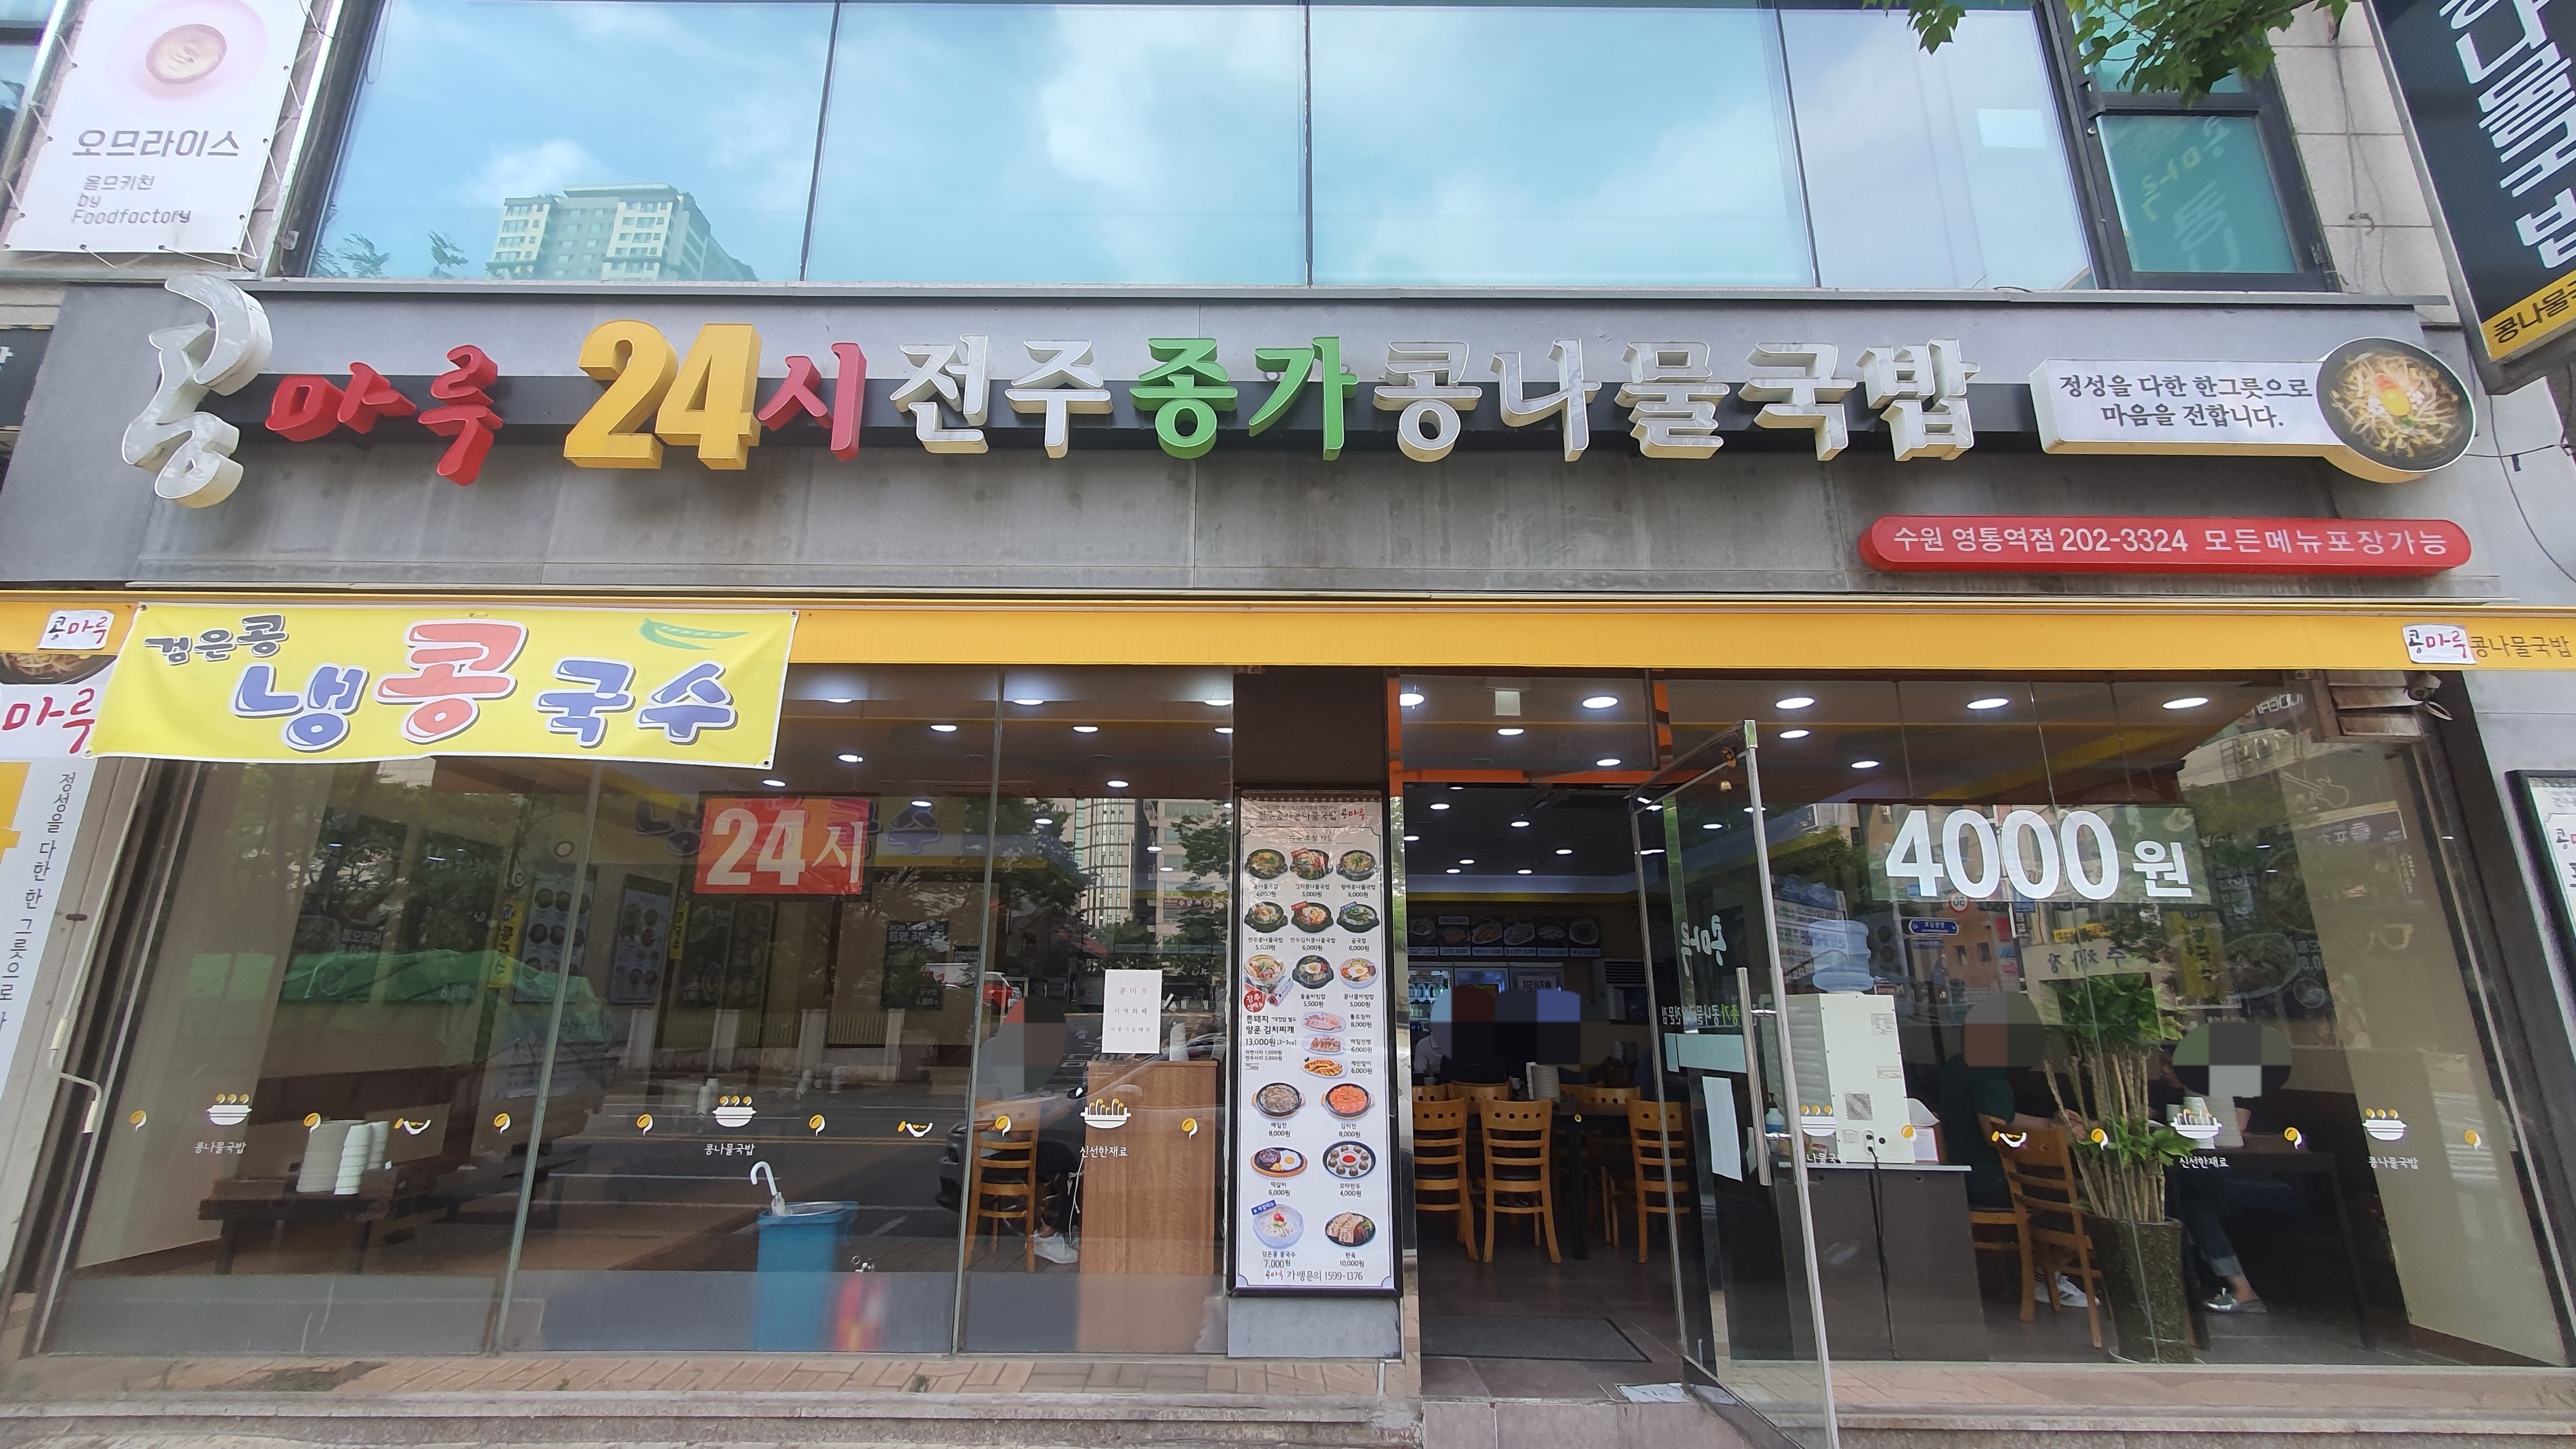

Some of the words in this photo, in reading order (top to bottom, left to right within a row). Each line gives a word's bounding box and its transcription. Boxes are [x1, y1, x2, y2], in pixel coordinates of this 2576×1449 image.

[72, 129, 239, 158] 오므라이스
[83, 174, 155, 191] 옴므키친
[77, 193, 102, 209] by
[70, 208, 192, 224] Foodfactory
[563, 319, 867, 471] 24시
[2059, 374, 2133, 399] 정성을
[2140, 375, 2187, 397] 다한
[2193, 376, 2314, 400] 한그릇으로
[2101, 402, 2176, 427] 마음을
[2182, 403, 2285, 429] 전합니다.
[1893, 527, 1943, 552] 수원
[1951, 527, 2055, 553] 영통역점
[2059, 527, 2188, 554] 202-3324
[2204, 528, 2447, 556] 모든메뉴포장가능
[48, 616, 107, 645] 콩마루
[144, 614, 289, 666] 검은콩
[2408, 629, 2467, 659] 콩마루
[2470, 634, 2572, 658] 콩나물국밥
[230, 618, 738, 753] 냉콩국수
[46, 771, 77, 834] 정성을
[1341, 808, 1365, 821] 콩마루
[705, 807, 868, 886] 24시
[32, 839, 58, 882] 다한
[1246, 993, 1262, 1003] 강추
[1246, 1015, 1269, 1024] 통돼지
[1246, 1025, 1261, 1035] 양푼
[1263, 1025, 1294, 1035] 김치찌개
[1246, 1038, 1276, 1047] 13,000원
[194, 1141, 247, 1156] 콩나물국밥
[704, 1143, 756, 1157] 콩나물국밥
[1079, 1145, 1129, 1158] 신선한재료
[1806, 1152, 1847, 1166] 나물국
[2177, 1154, 2230, 1169] 신선한재료
[2367, 1155, 2419, 1170] 콩나물국밥
[1264, 1259, 1291, 1268] 7,000원
[1339, 1259, 1365, 1268] 10,000원
[1287, 1270, 1322, 1282] 가맹문의
[1324, 1271, 1363, 1281] 1599-1376
